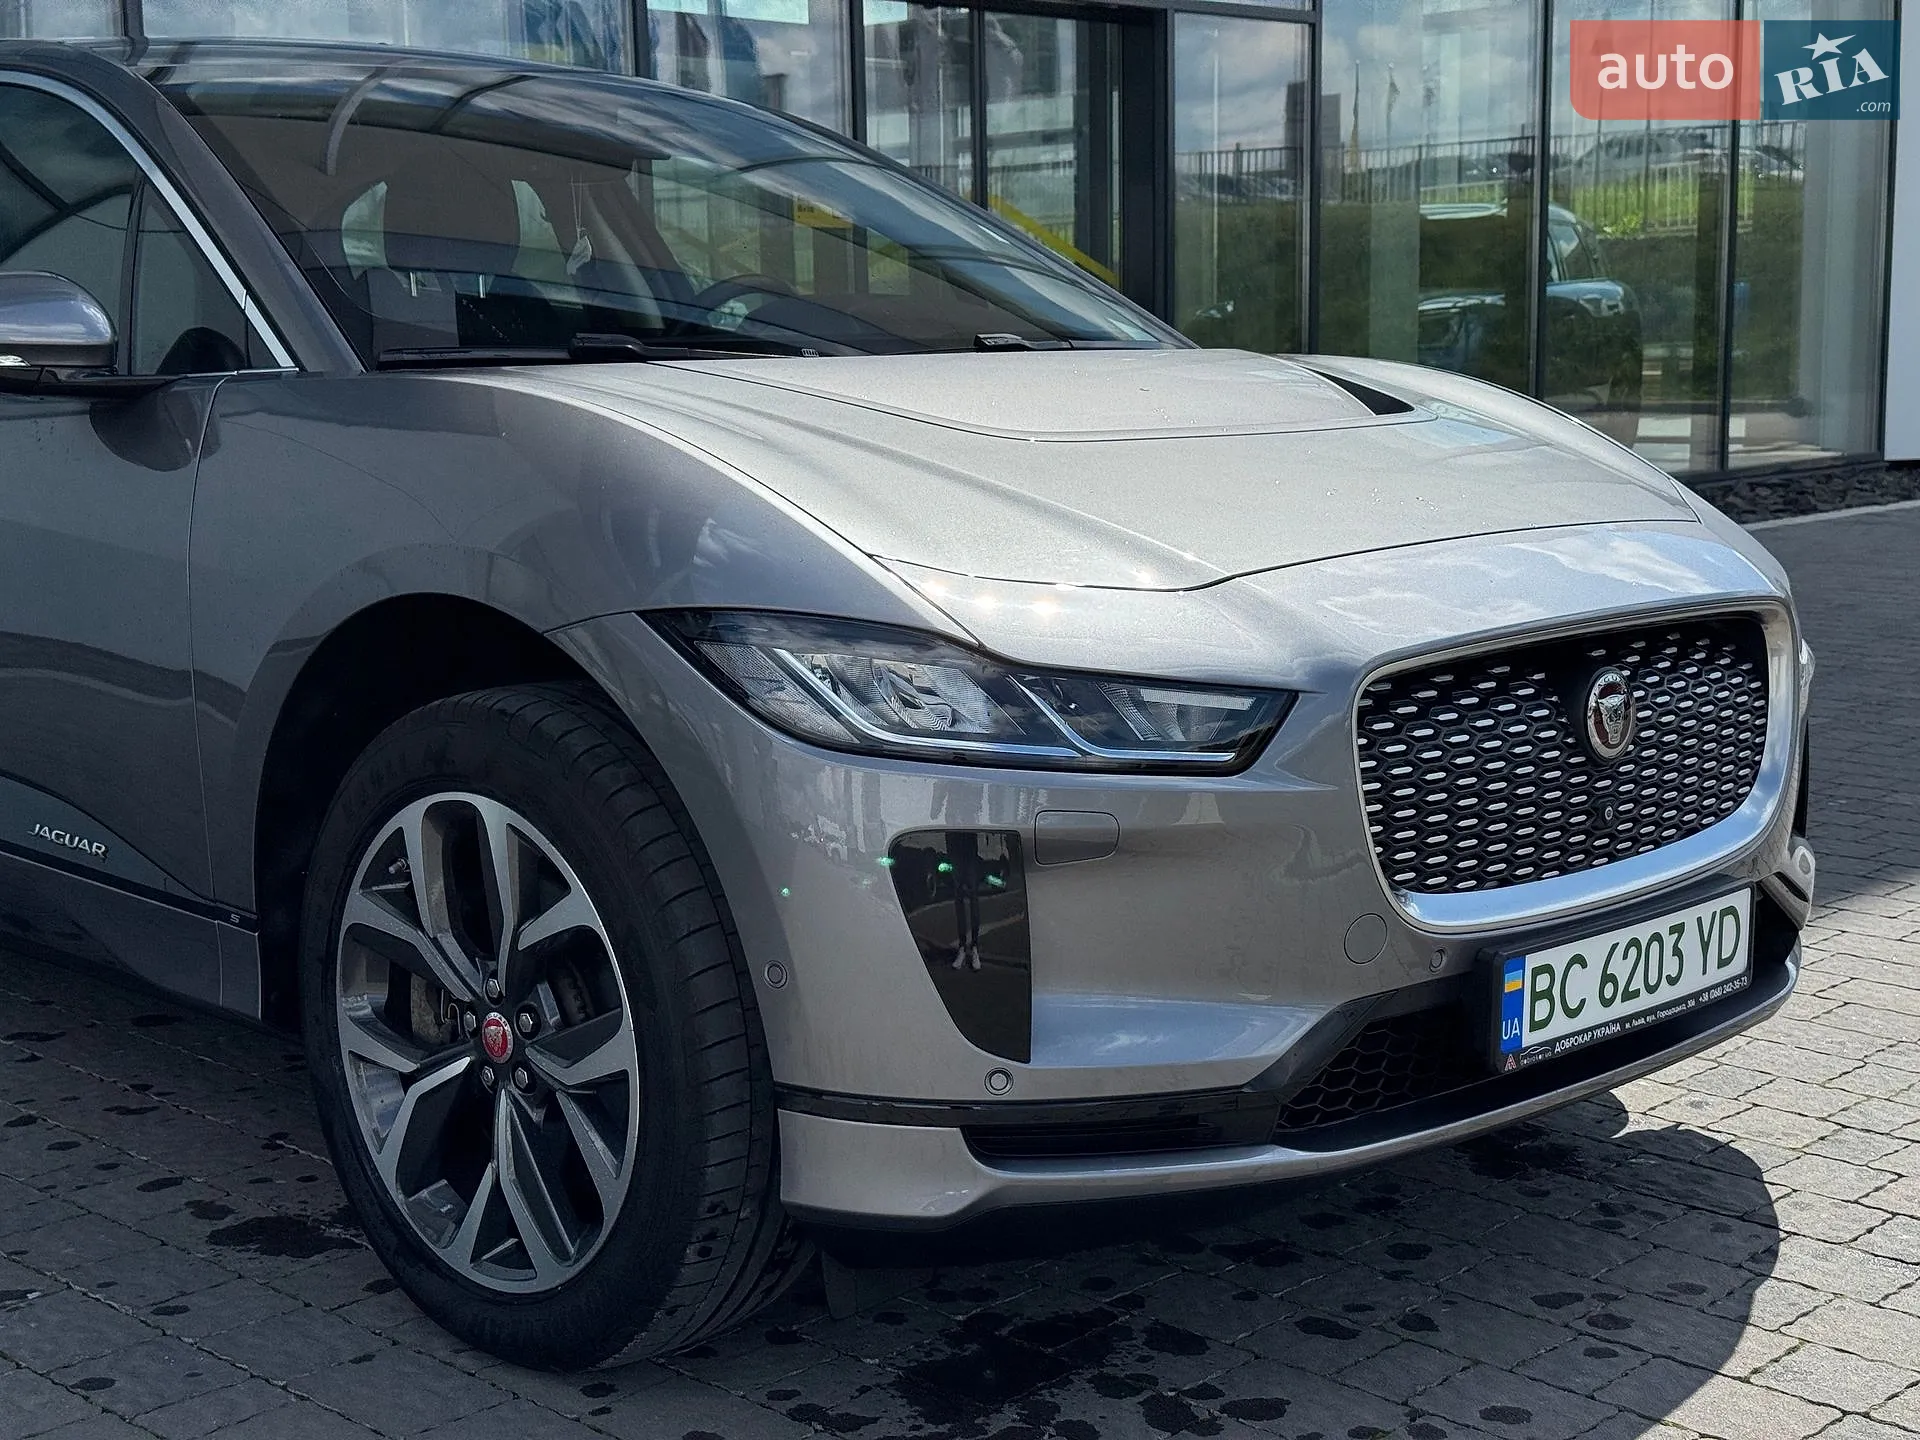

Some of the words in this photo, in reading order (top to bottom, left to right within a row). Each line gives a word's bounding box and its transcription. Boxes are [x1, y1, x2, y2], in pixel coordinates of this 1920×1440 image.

[27, 823, 108, 861] JAGUAR
[230, 913, 241, 924] S
[1528, 953, 1588, 1032] BC
[1598, 922, 1686, 1008] 6203
[1696, 905, 1741, 976] YD
[1502, 1018, 1521, 1040] UA
[1554, 1032, 1592, 1054] ДОБРОКАР
[1593, 1022, 1621, 1039] УКРАЇНА
